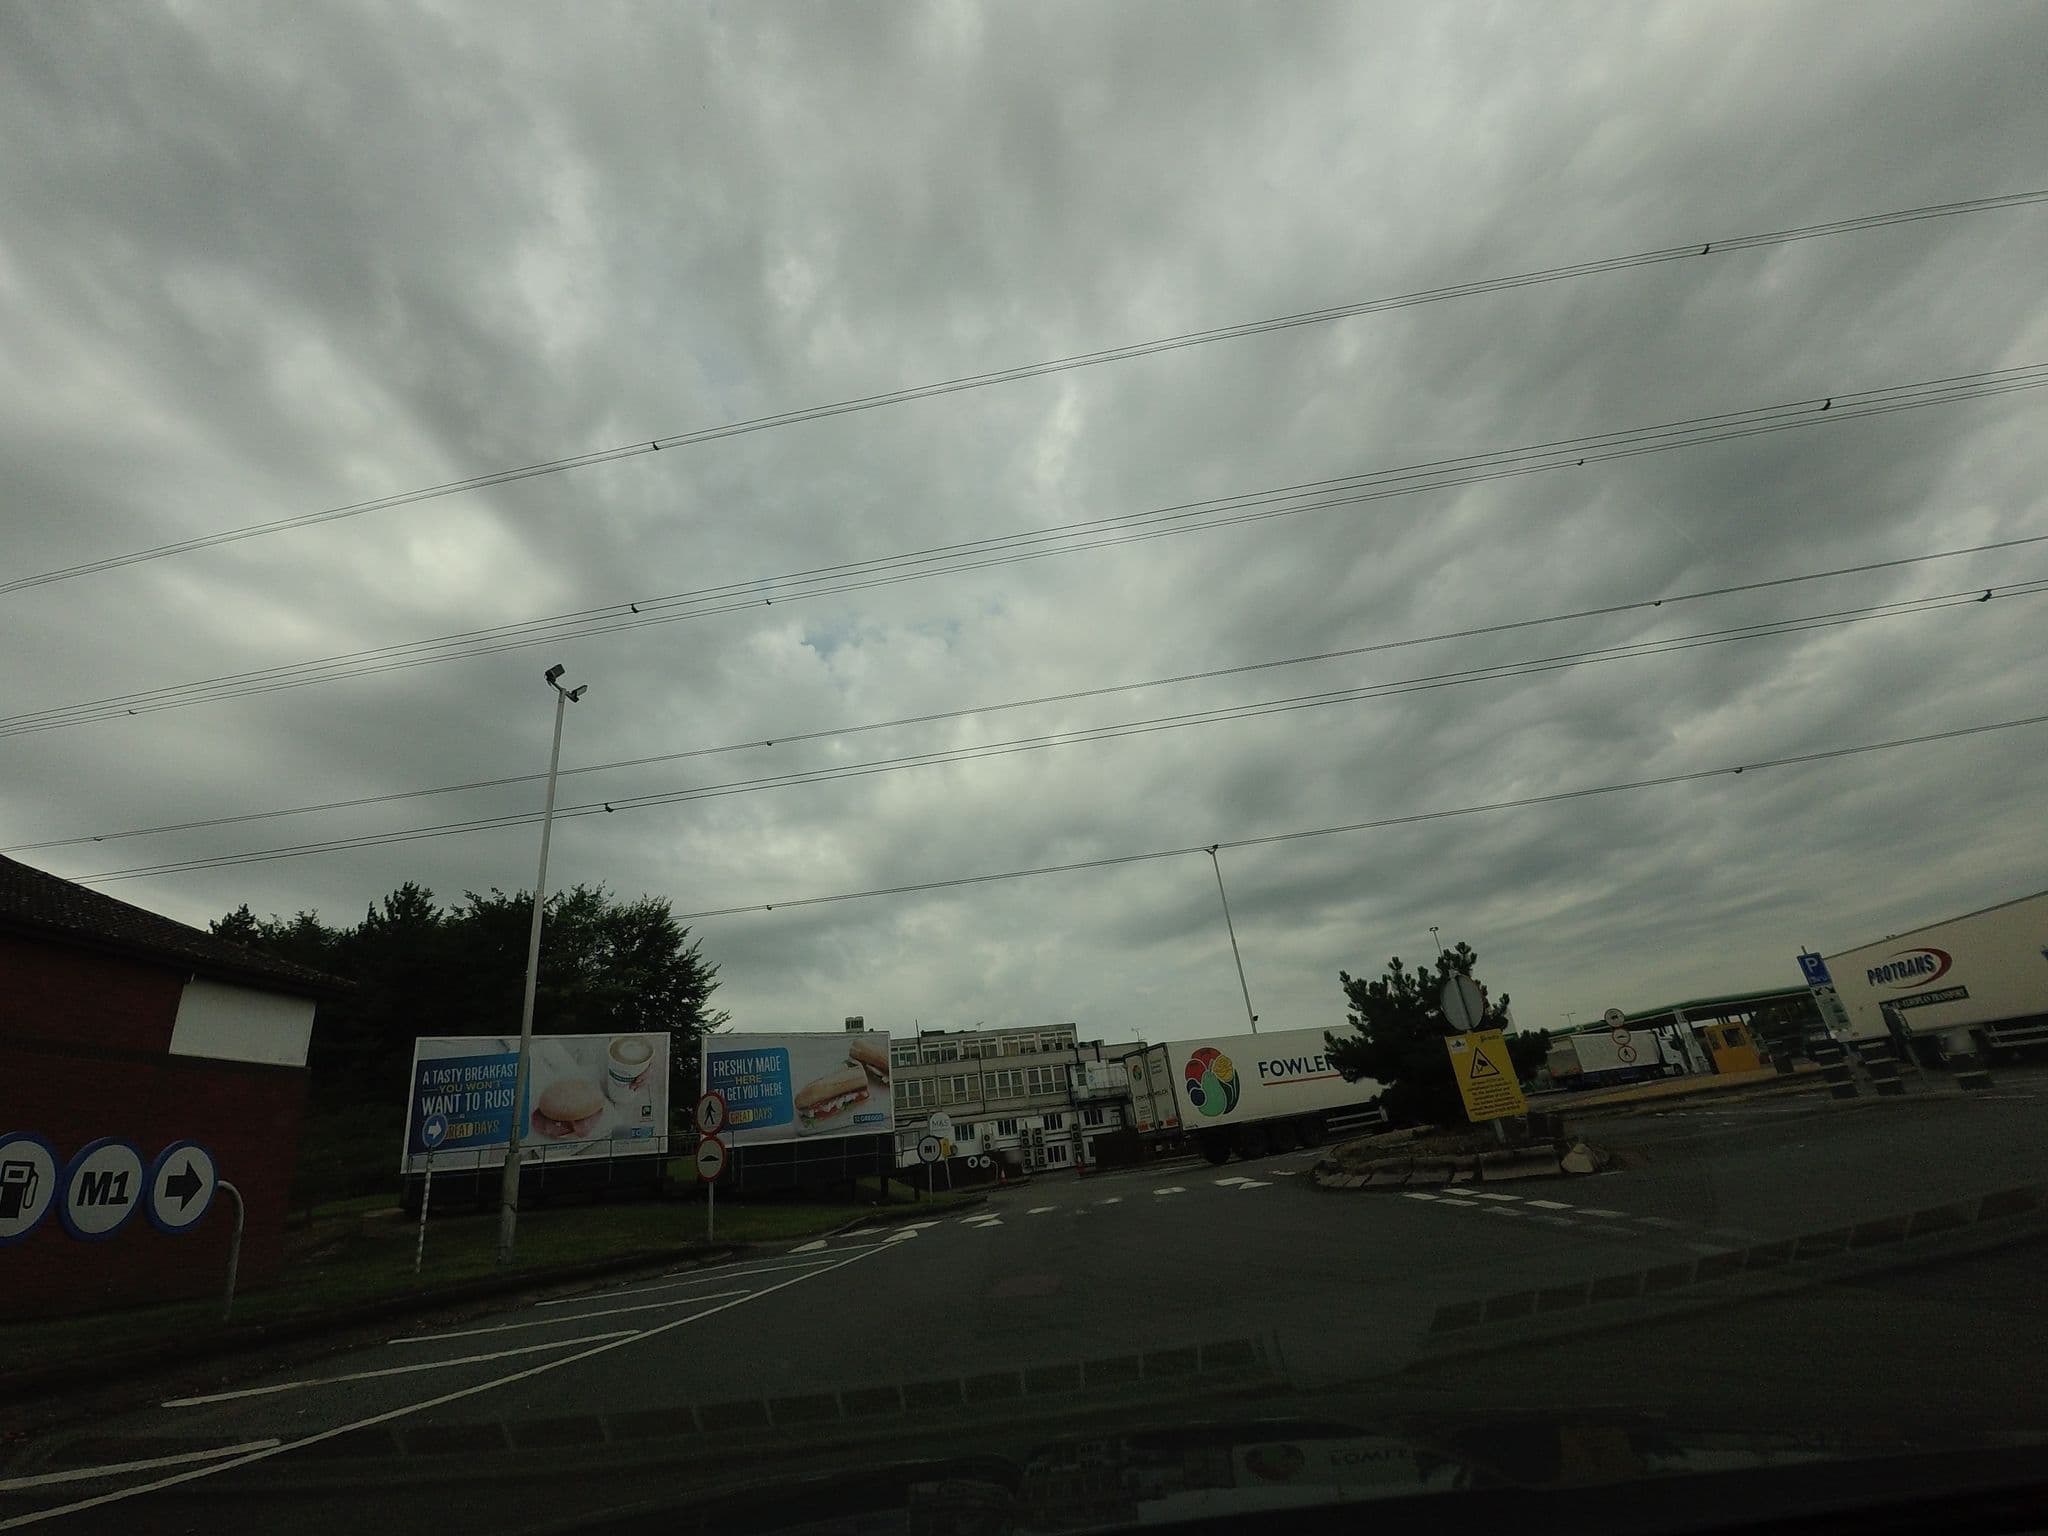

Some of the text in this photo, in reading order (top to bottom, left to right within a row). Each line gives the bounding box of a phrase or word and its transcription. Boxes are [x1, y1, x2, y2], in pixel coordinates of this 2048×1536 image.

[1804, 958, 1819, 974] P
[1867, 954, 1936, 986] PROTRANS
[422, 1063, 519, 1085] A TASTY BREAKFAST
[713, 1055, 782, 1077] FRESHLY MADE
[439, 1080, 502, 1093] YOU WON'T
[735, 1075, 763, 1085] HERE
[727, 1085, 743, 1101] GET
[742, 1083, 760, 1100] YOU
[760, 1081, 783, 1097] THERE
[422, 1093, 461, 1116] WANT
[465, 1092, 481, 1112] TO
[752, 1106, 773, 1120] DAYS
[447, 1119, 500, 1139] REAT DAYS
[77, 1170, 129, 1206] M1
